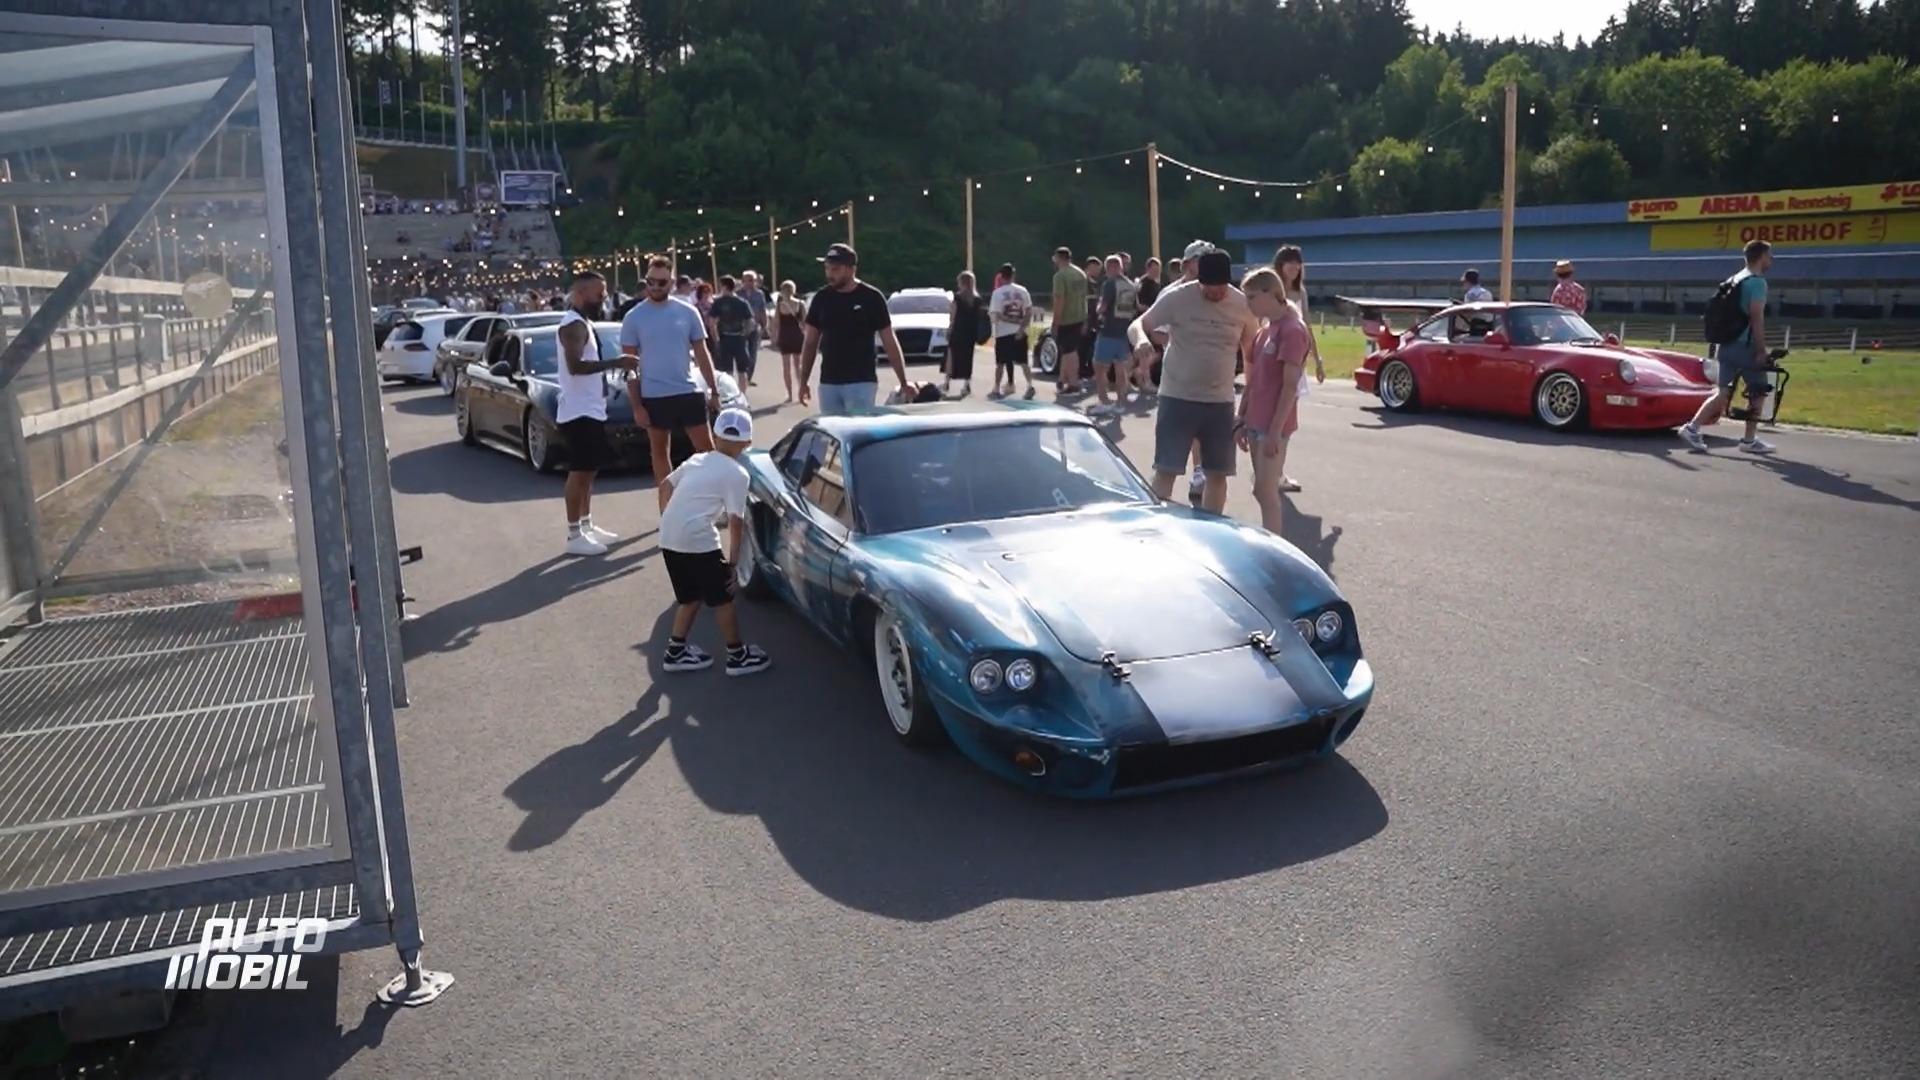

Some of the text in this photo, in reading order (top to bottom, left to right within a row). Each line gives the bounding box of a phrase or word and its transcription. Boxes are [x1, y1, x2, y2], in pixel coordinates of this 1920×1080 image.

[1643, 200, 1678, 214] LOTTO
[1699, 193, 1852, 214] ARENA am Rennsteig
[1740, 222, 1852, 242] OBERHOF
